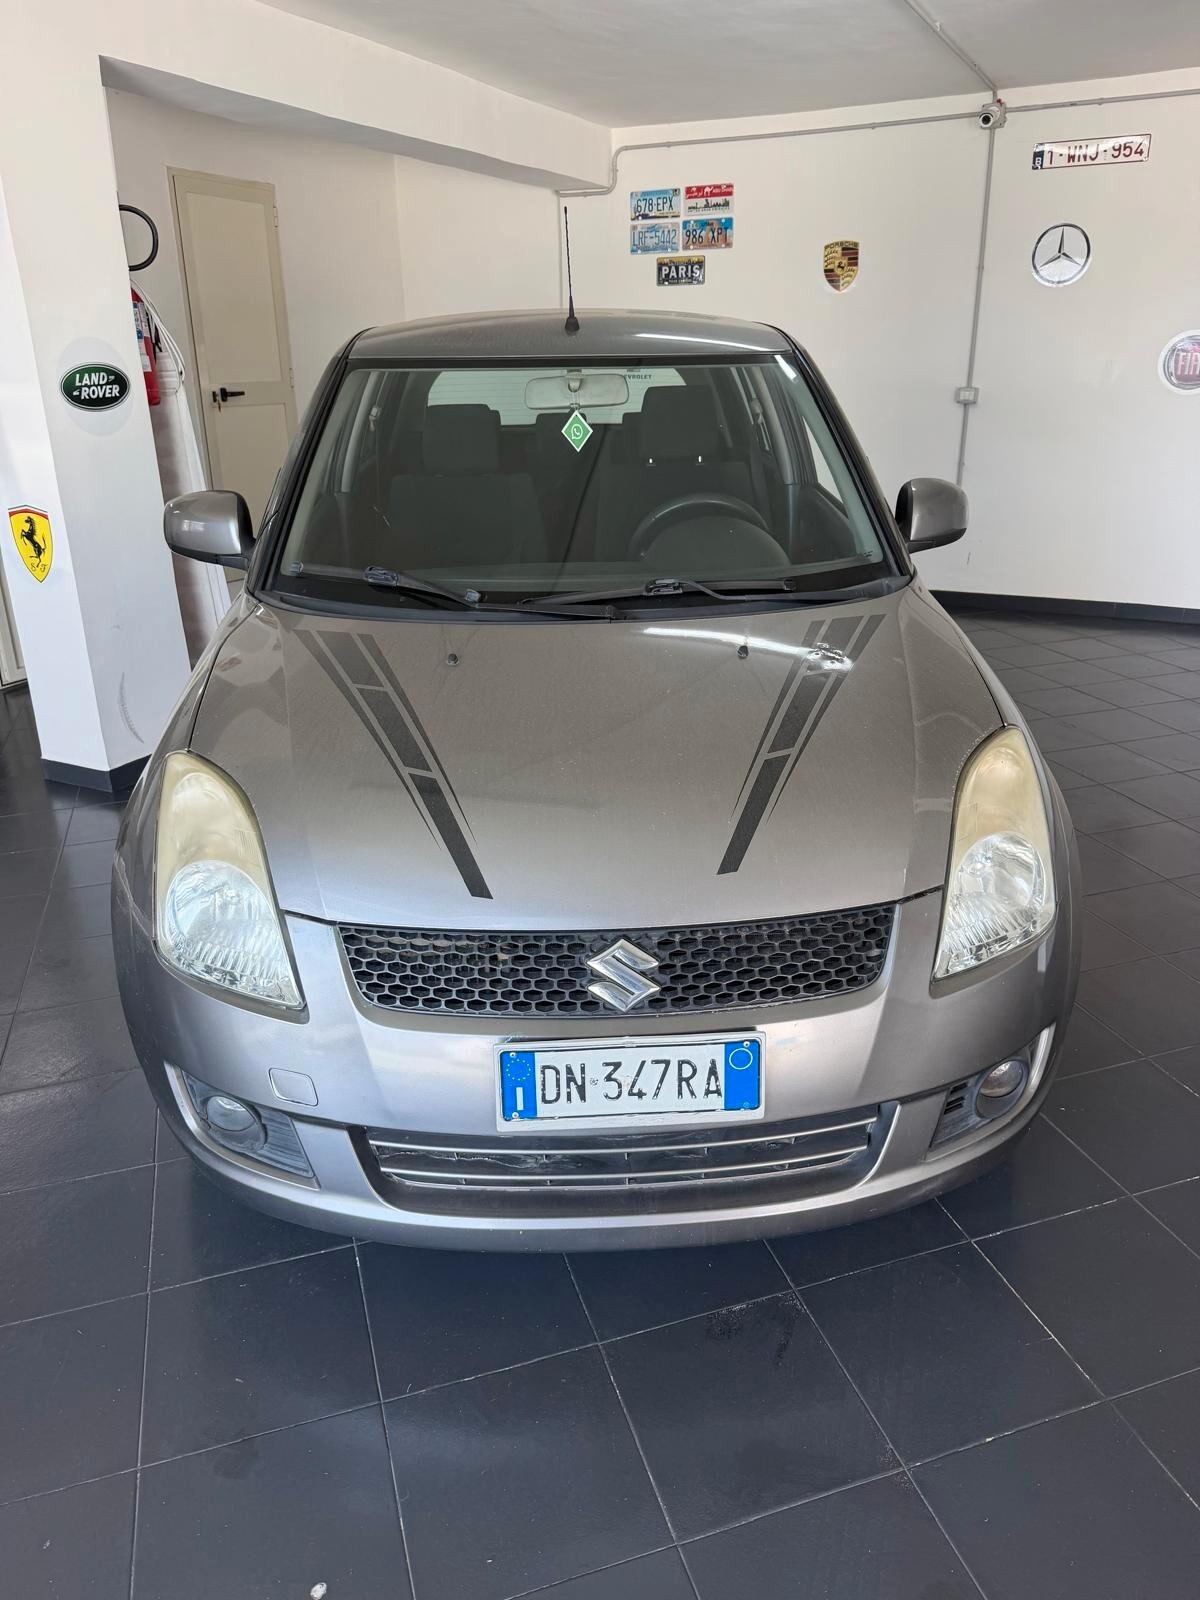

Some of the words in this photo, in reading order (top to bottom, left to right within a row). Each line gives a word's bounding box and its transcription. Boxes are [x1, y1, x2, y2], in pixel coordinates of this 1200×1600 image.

[685, 228, 704, 245] 986
[823, 240, 860, 251] PORSCHE
[661, 265, 700, 279] PARIS
[75, 371, 108, 387] LAND
[80, 384, 120, 400] ROVER
[539, 1062, 588, 1105] DN
[602, 1057, 724, 1101] 347RA
